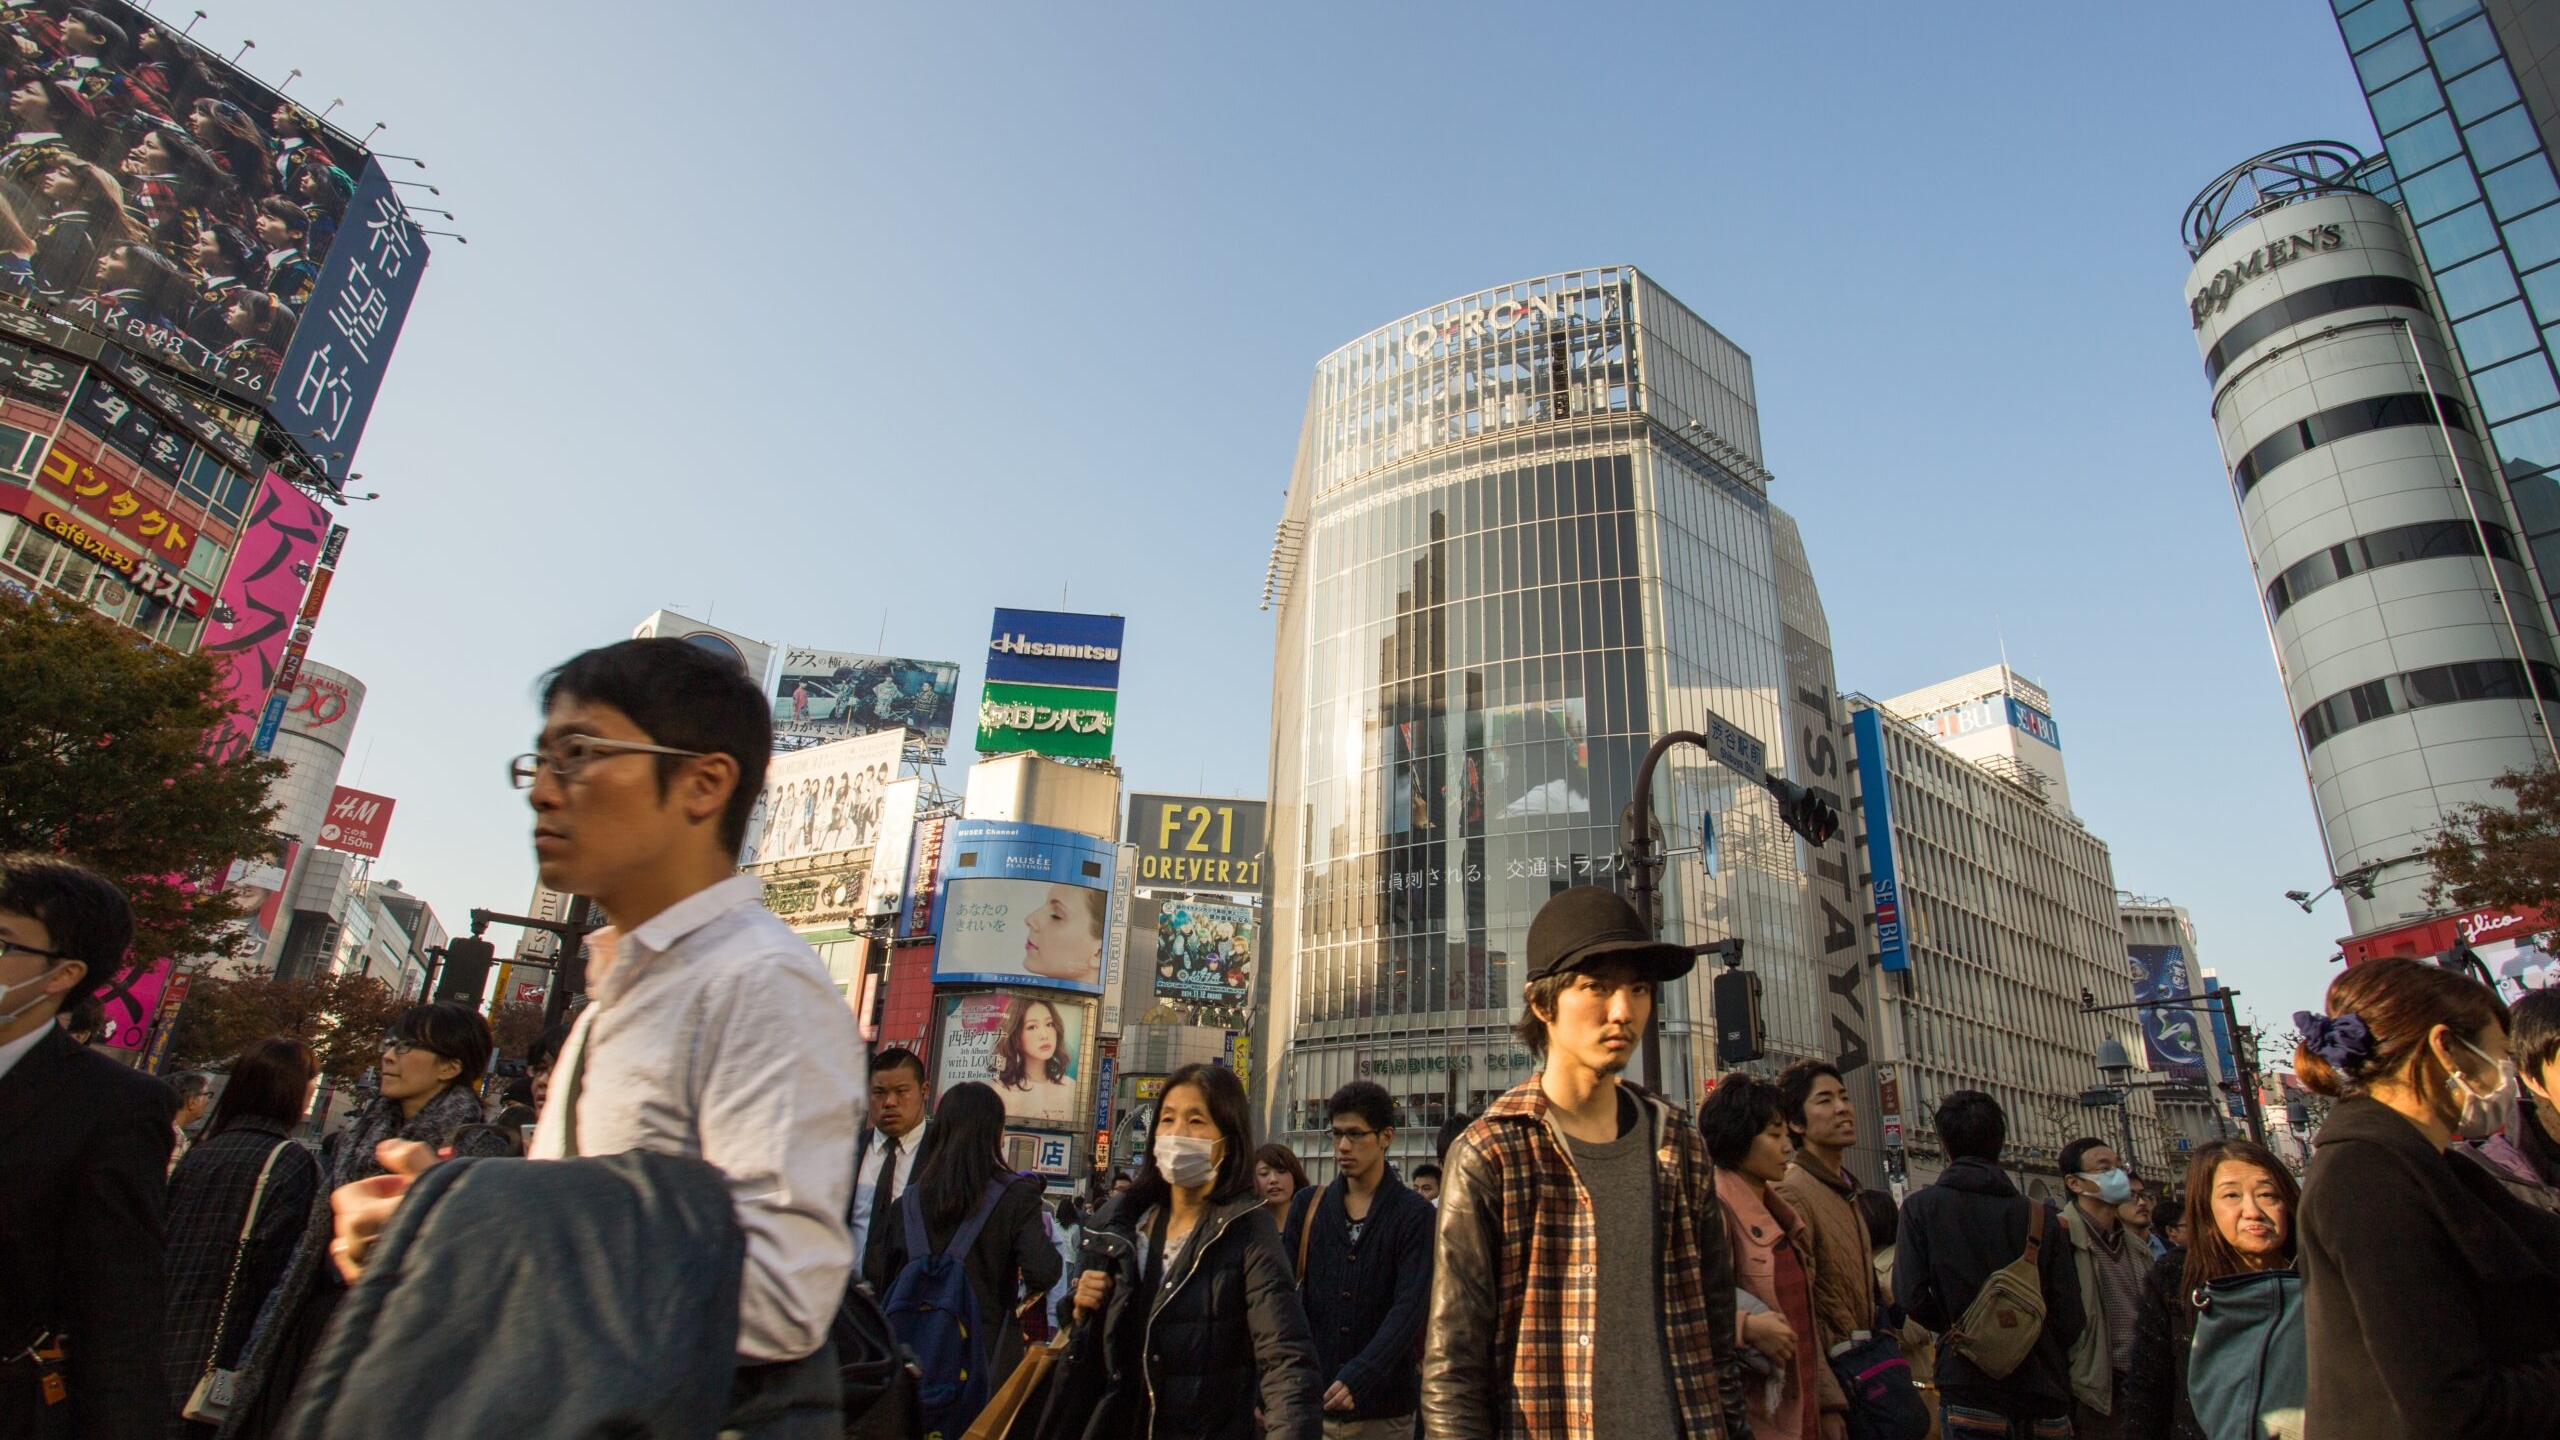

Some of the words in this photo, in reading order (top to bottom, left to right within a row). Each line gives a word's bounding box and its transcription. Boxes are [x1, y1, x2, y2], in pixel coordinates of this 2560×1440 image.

[78, 300, 183, 354] AKB48
[234, 366, 262, 390] 26
[100, 380, 116, 394] 9F
[43, 448, 187, 549] コンタクト
[131, 560, 198, 608] ガスト
[990, 632, 1119, 662] Hisamitsu
[282, 655, 300, 682] ガスト
[297, 673, 349, 697] HIBUYA
[988, 702, 1109, 736] サロンパス
[1919, 702, 1994, 742] EIBU
[2014, 706, 2057, 746] SEIBU
[1711, 720, 1760, 766] 渋谷駅前
[1720, 747, 1744, 769] Shibuya
[333, 796, 380, 825] H&M
[341, 834, 374, 850] 150m
[344, 826, 368, 838] この先
[986, 828, 1019, 836] Channel
[1159, 804, 1233, 853] F21
[1142, 855, 1230, 883] OREVER
[1236, 861, 1258, 885] 21
[526, 890, 558, 954] Essnti
[956, 902, 1009, 916] あなたの
[1873, 880, 1900, 953] SEIBU
[955, 919, 1007, 933] きれいを
[2459, 914, 2524, 943] Glico
[1106, 932, 1122, 985] neon
[948, 1028, 1007, 1047] 西野カナ
[971, 1047, 989, 1055] Album
[948, 1057, 968, 1068] with
[971, 1055, 1002, 1068] LOVE
[1360, 1053, 1473, 1076] STARBUCKS
[1040, 1141, 1065, 1166] 店
